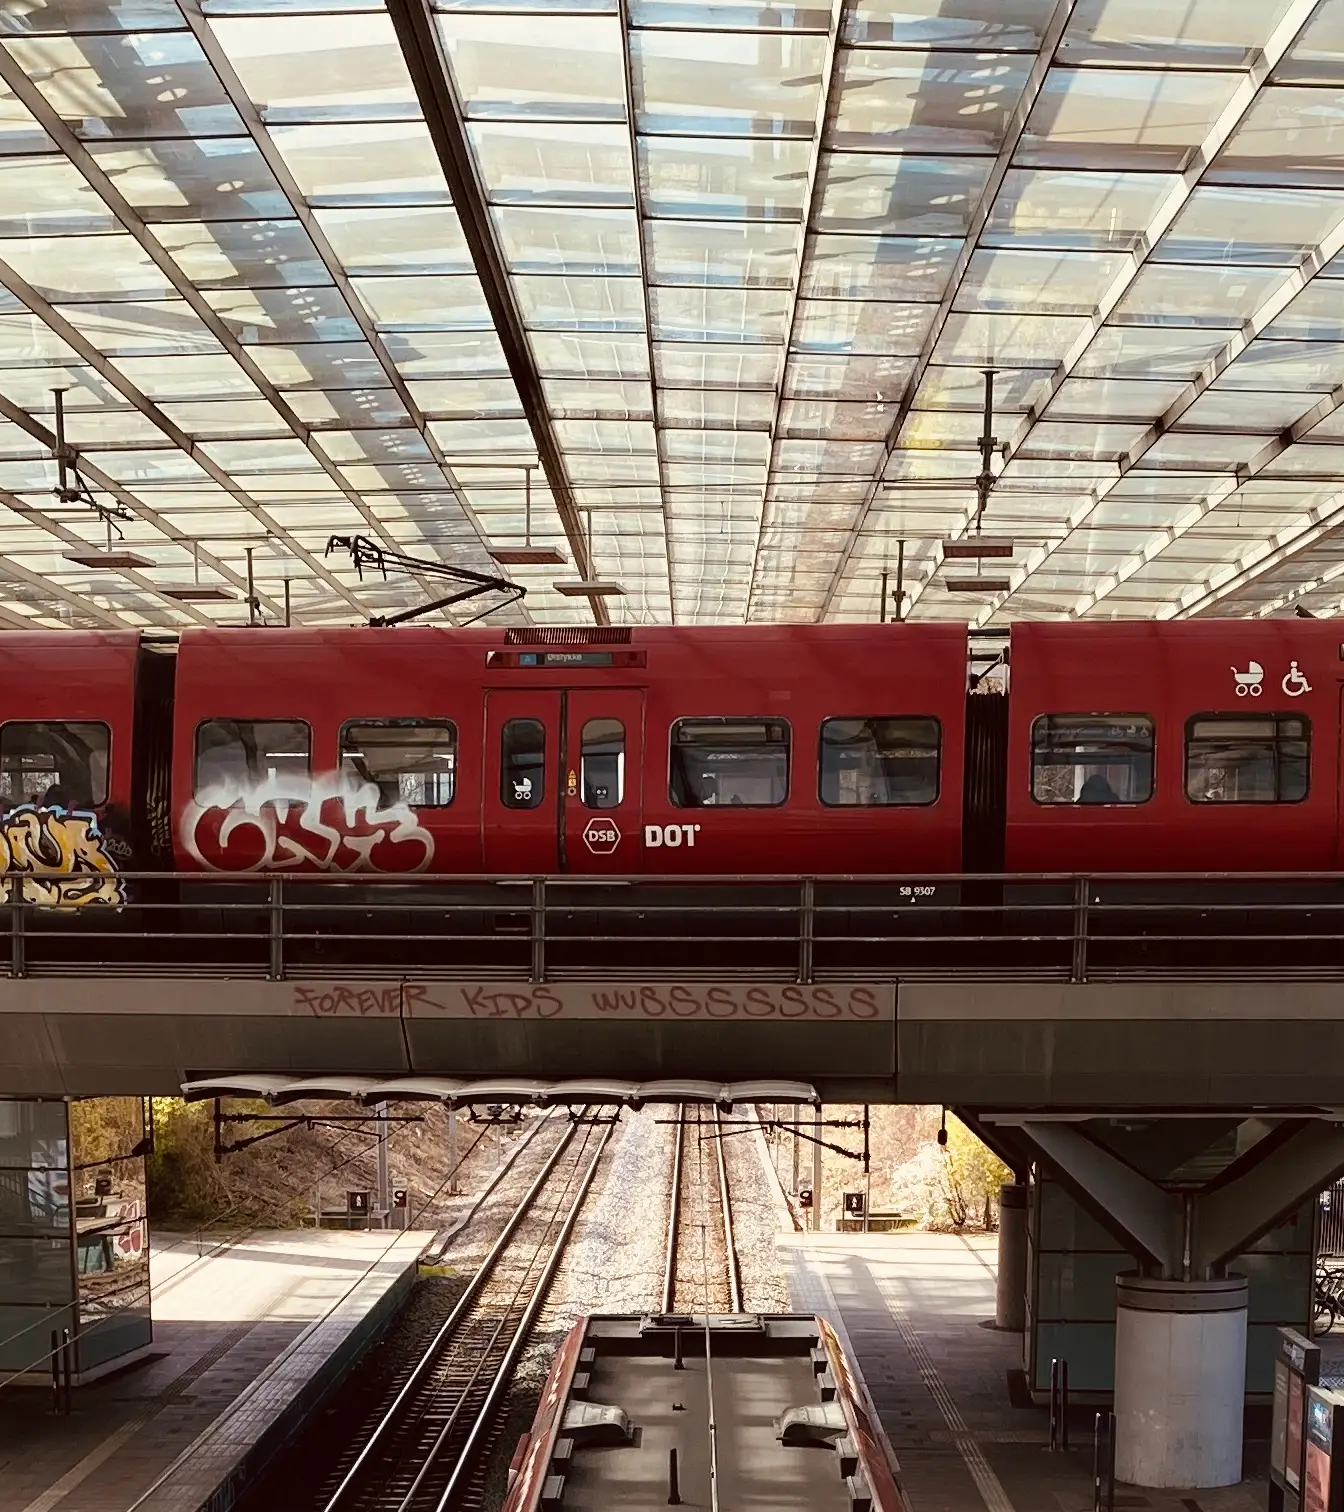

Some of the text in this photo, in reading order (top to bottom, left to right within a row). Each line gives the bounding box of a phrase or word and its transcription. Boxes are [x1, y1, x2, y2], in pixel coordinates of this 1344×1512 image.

[588, 830, 616, 842] DSB
[645, 824, 701, 848] DOT
[293, 986, 447, 1018] FOREVER
